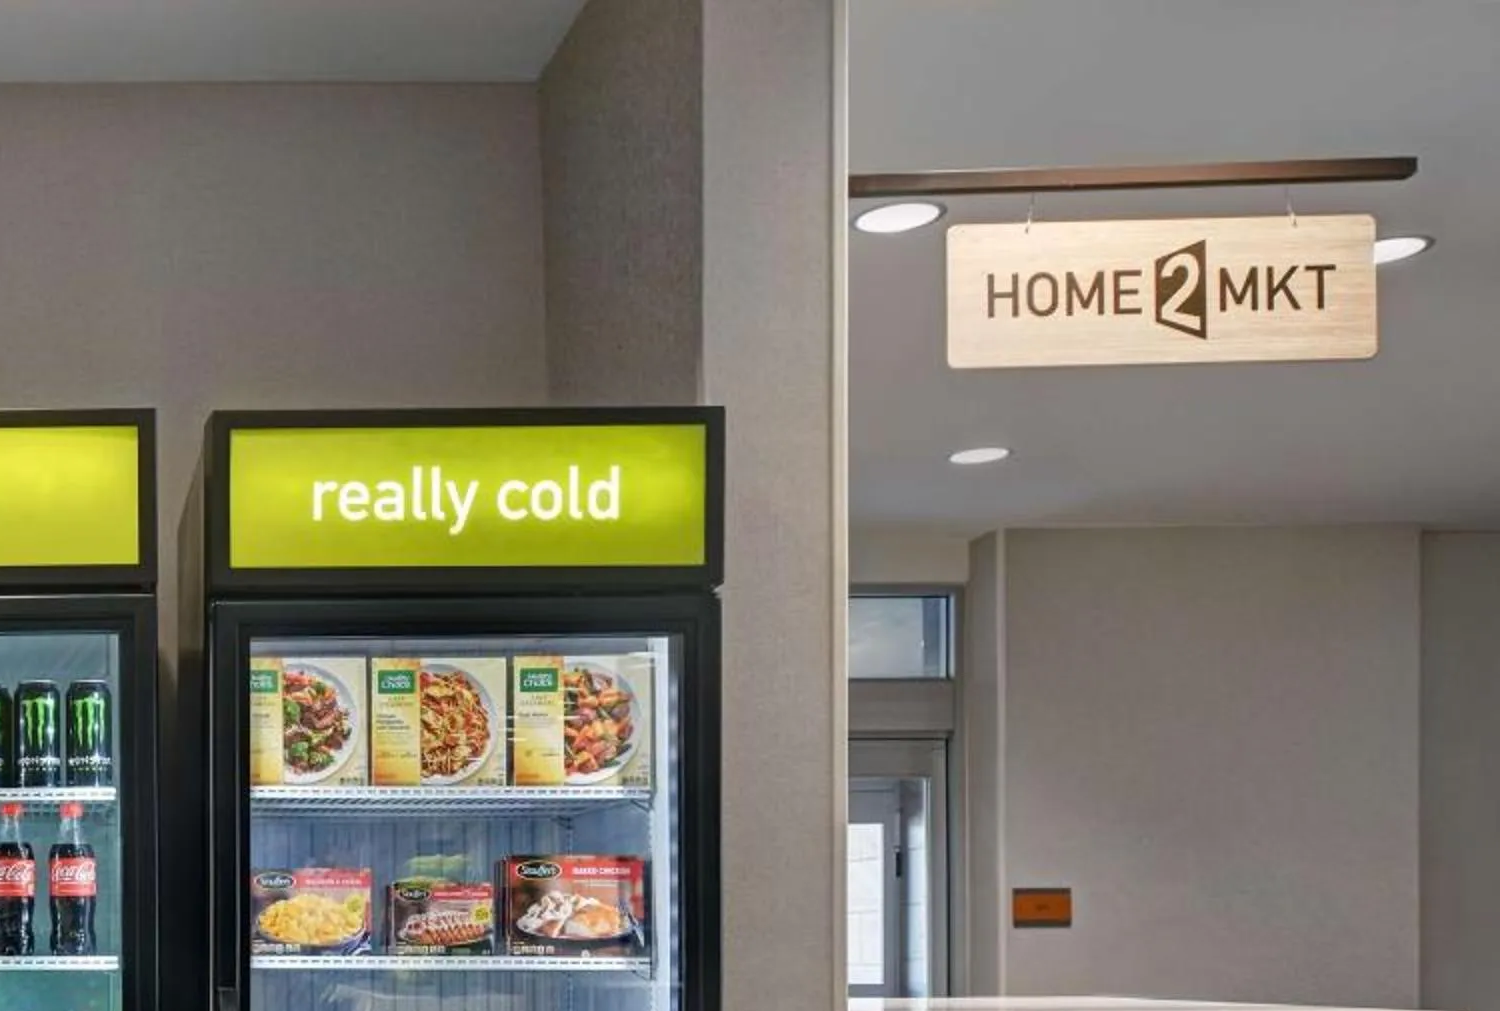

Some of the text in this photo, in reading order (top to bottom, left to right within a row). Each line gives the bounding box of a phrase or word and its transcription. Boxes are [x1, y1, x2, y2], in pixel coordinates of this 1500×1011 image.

[986, 240, 1337, 340] HOME 2 MKT
[311, 465, 621, 536] really cold
